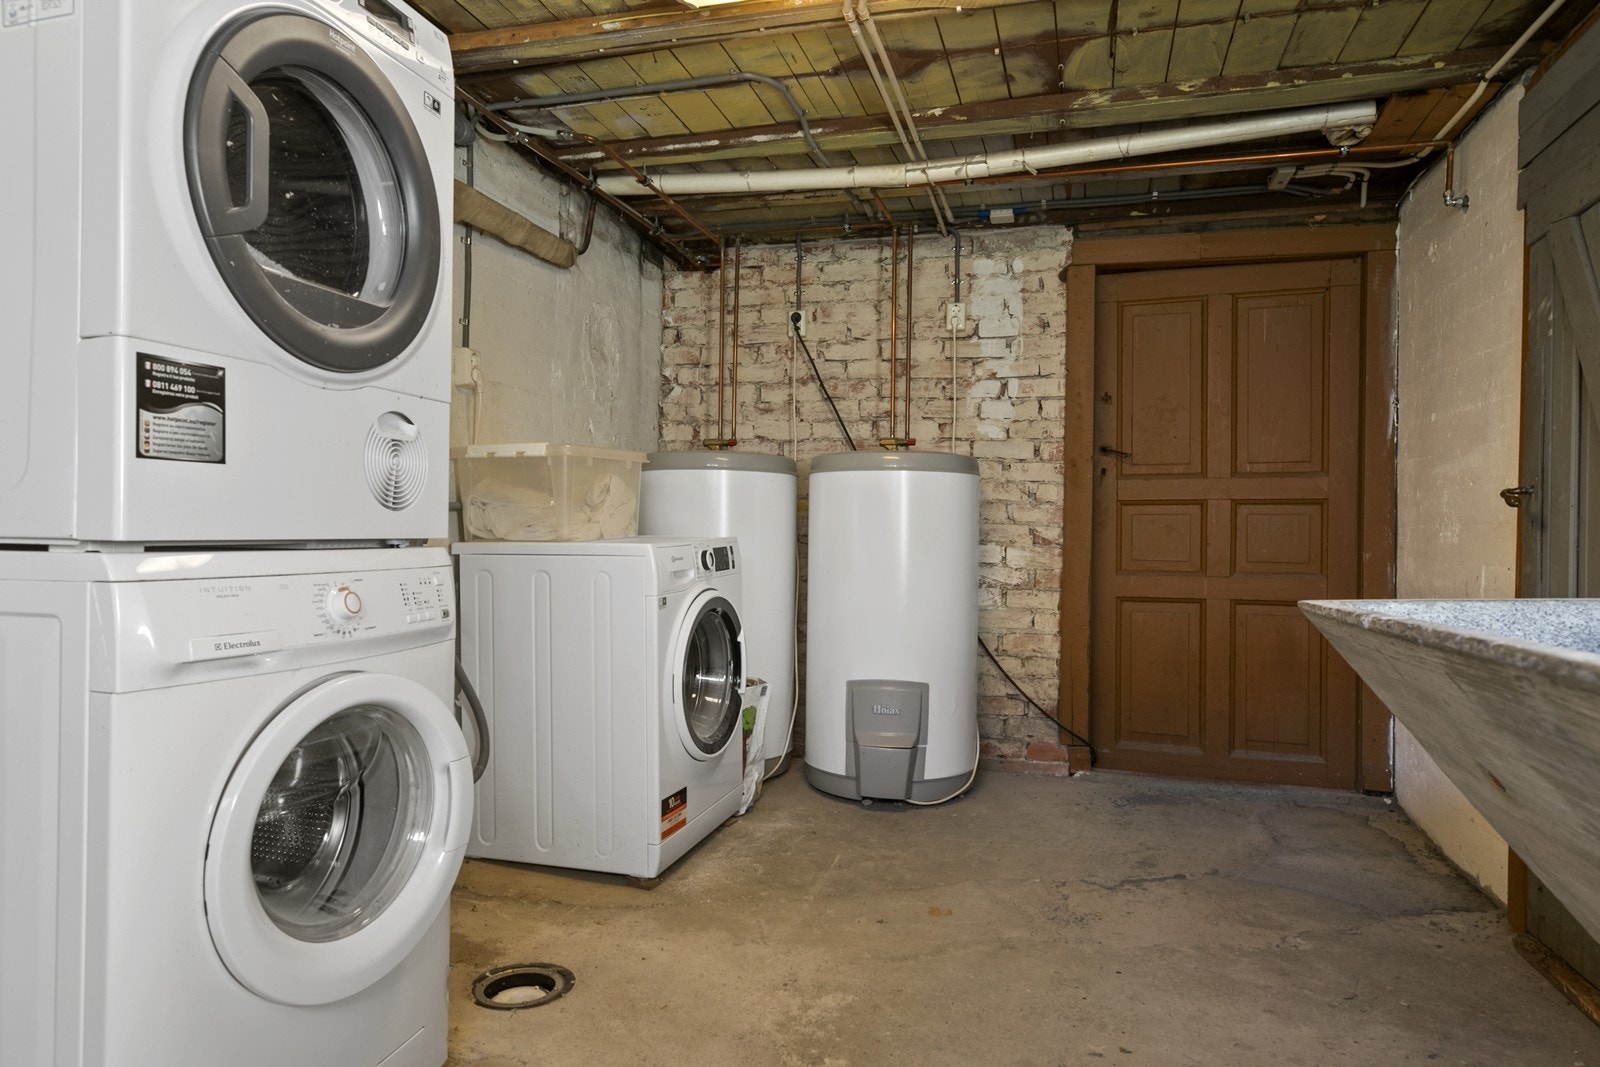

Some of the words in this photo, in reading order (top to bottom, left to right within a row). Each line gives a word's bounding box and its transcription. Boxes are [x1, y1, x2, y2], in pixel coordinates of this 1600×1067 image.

[329, 29, 356, 53] Hotpoint
[152, 363, 165, 372] 800
[166, 365, 179, 374] 894
[179, 367, 192, 376] 054
[152, 380, 169, 390] 0811
[170, 383, 183, 392] 469
[184, 385, 196, 394] 100
[152, 415, 217, 427] www.hotpoint.eu/register
[198, 585, 251, 593] INTUITION
[223, 639, 261, 650] Electrolux
